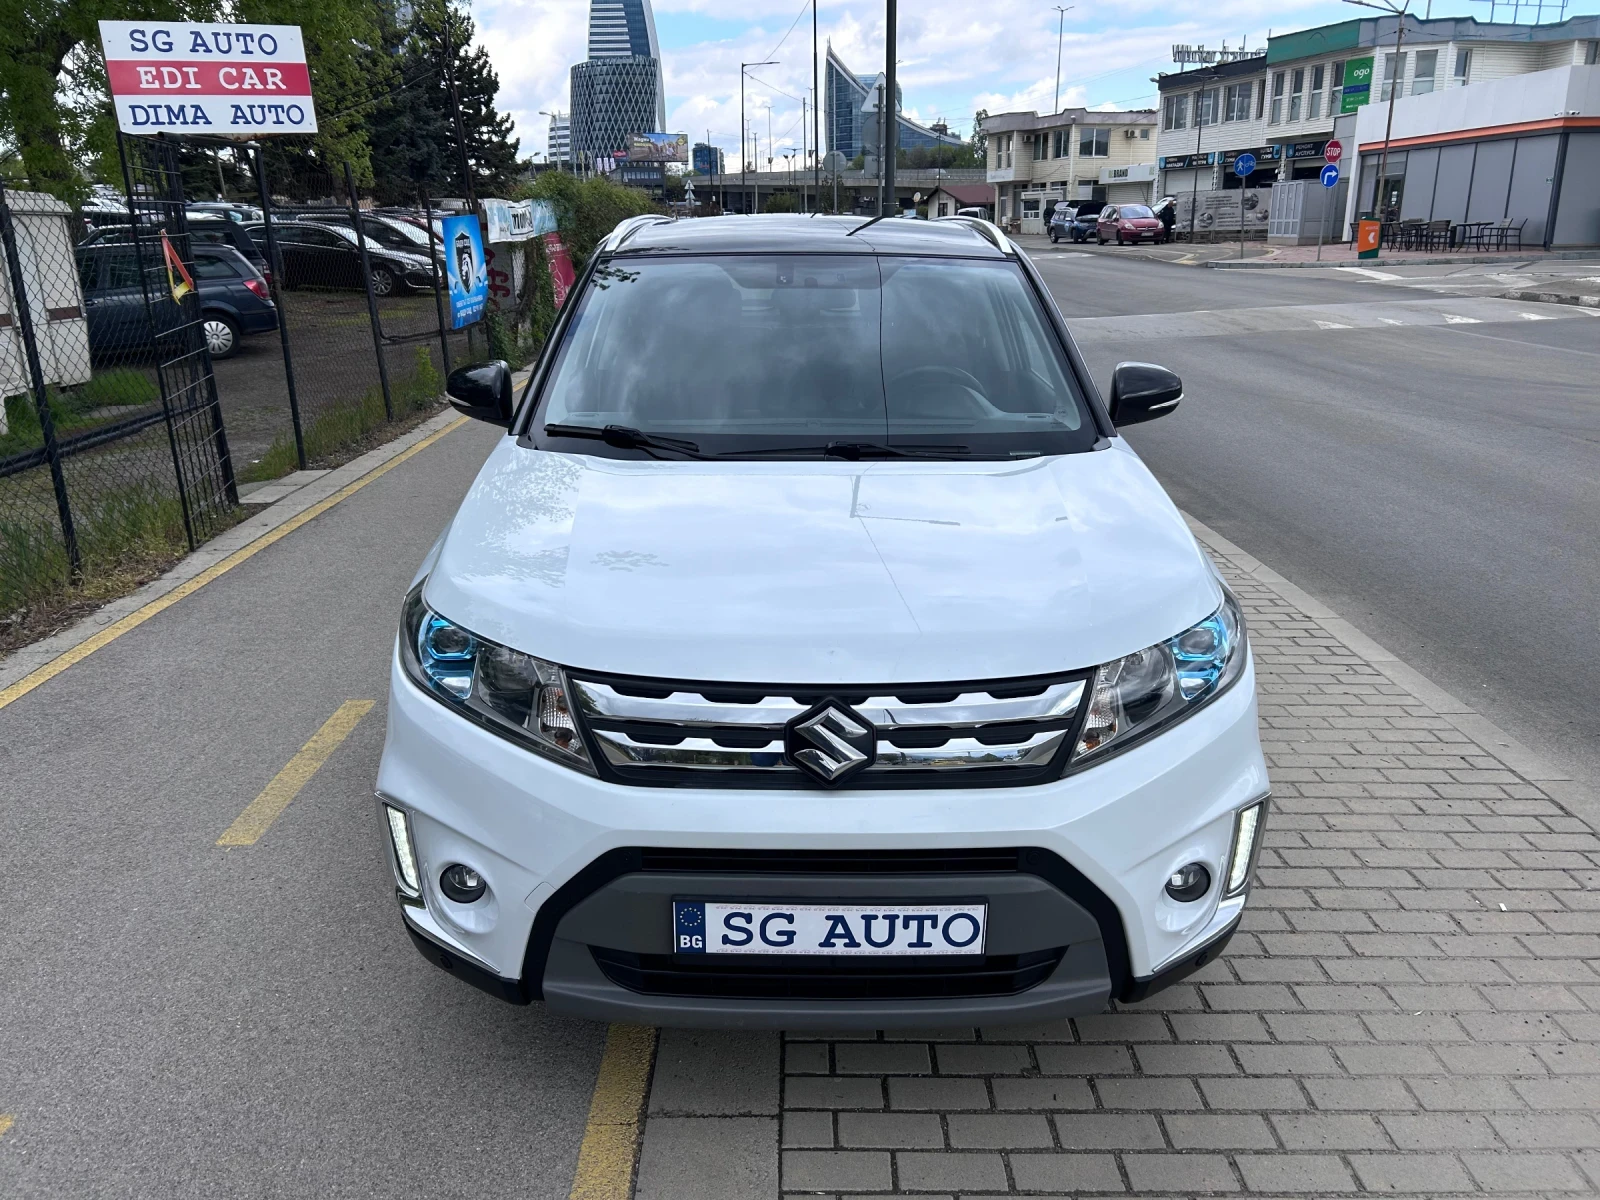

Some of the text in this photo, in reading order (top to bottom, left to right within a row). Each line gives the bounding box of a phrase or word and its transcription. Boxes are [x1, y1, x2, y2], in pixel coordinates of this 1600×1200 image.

[128, 28, 278, 56] SG AUTO
[136, 66, 287, 90] EDI CAR
[128, 104, 305, 126] DIMA AUTO
[1326, 147, 1341, 156] STOP
[679, 934, 703, 949] BG
[721, 911, 981, 949] SG AUTO
